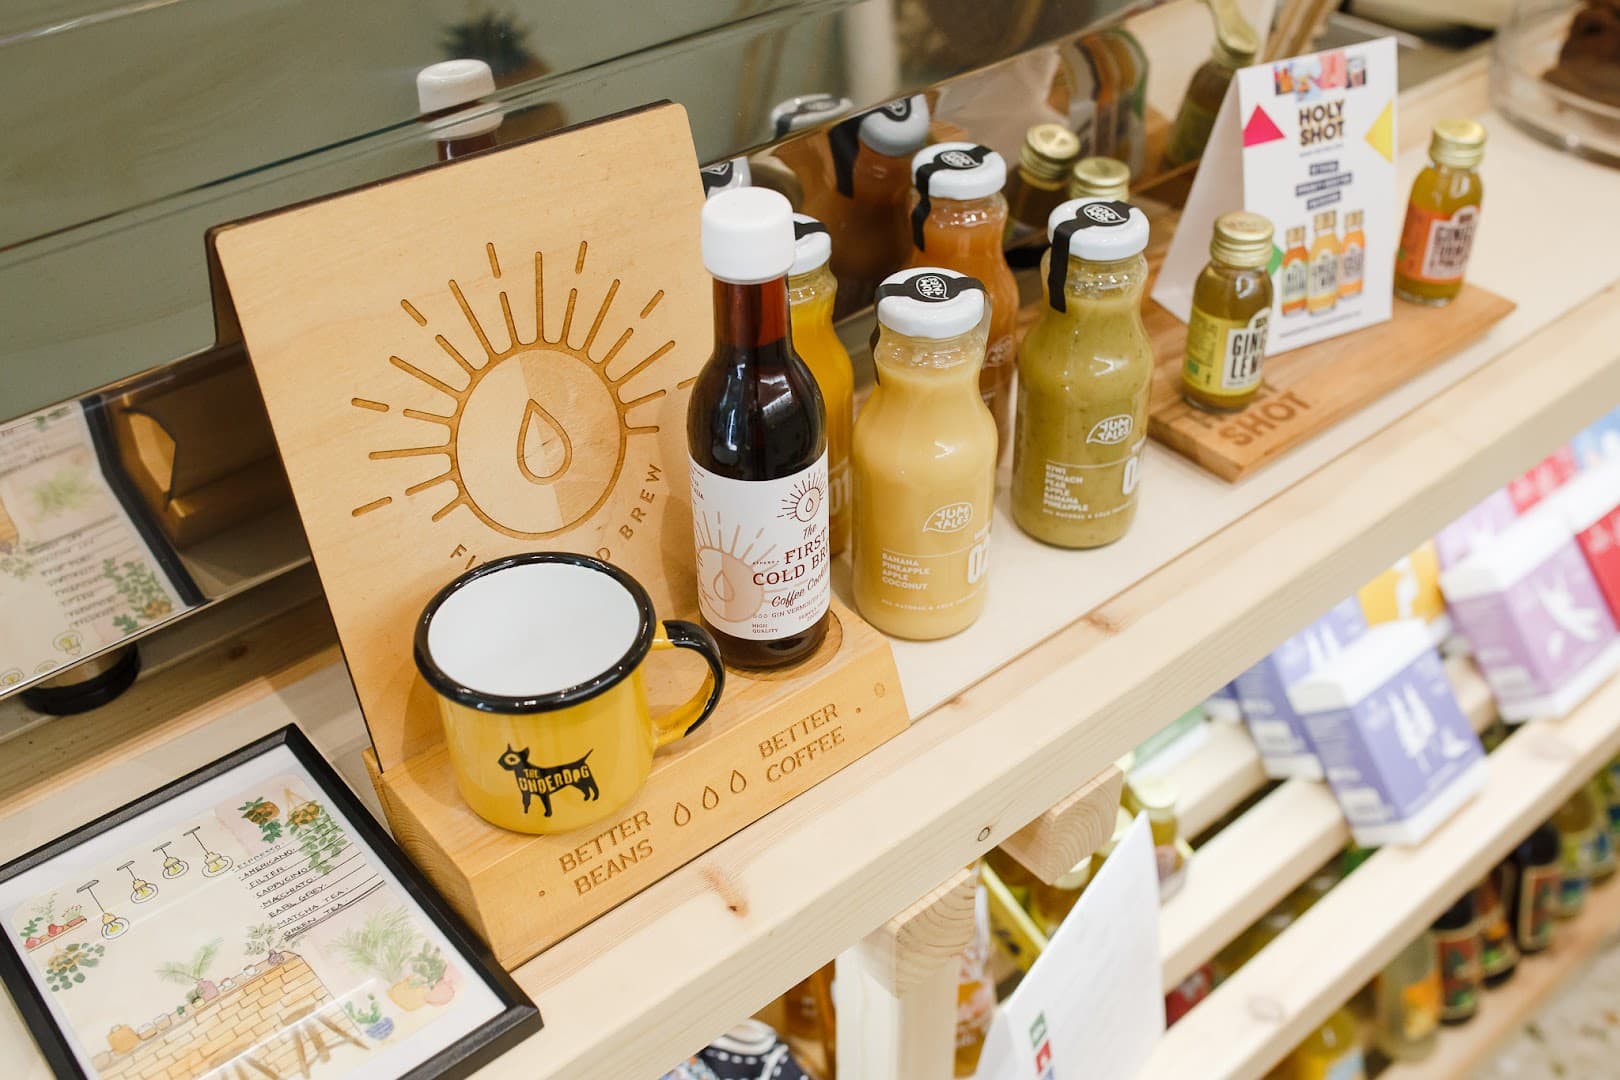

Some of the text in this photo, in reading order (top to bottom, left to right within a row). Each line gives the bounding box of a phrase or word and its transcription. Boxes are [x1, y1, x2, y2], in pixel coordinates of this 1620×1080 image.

[1299, 99, 1344, 126] HOLY
[1300, 120, 1345, 147] SHOT
[1219, 391, 1310, 446] SHOT
[617, 463, 662, 541] BREW
[803, 523, 817, 540] The
[785, 527, 827, 565] FIRST
[882, 553, 920, 566] BANANA
[753, 564, 806, 586] COLD
[882, 560, 930, 575] PINEAPPLE
[882, 570, 909, 581] APPLE
[882, 576, 928, 591] COCONUT
[771, 589, 805, 608] Coffee
[772, 611, 785, 619] GIN
[758, 703, 839, 761] BETTER
[766, 725, 845, 783] COFFEE
[518, 765, 590, 794] UNDERDOG
[523, 768, 540, 779] THE
[559, 810, 651, 875] BETTER
[574, 839, 653, 897] BEANS
[269, 902, 297, 918] EARL
[278, 890, 345, 927] MATCHA TEA
[283, 903, 344, 937] GREEN TEA
